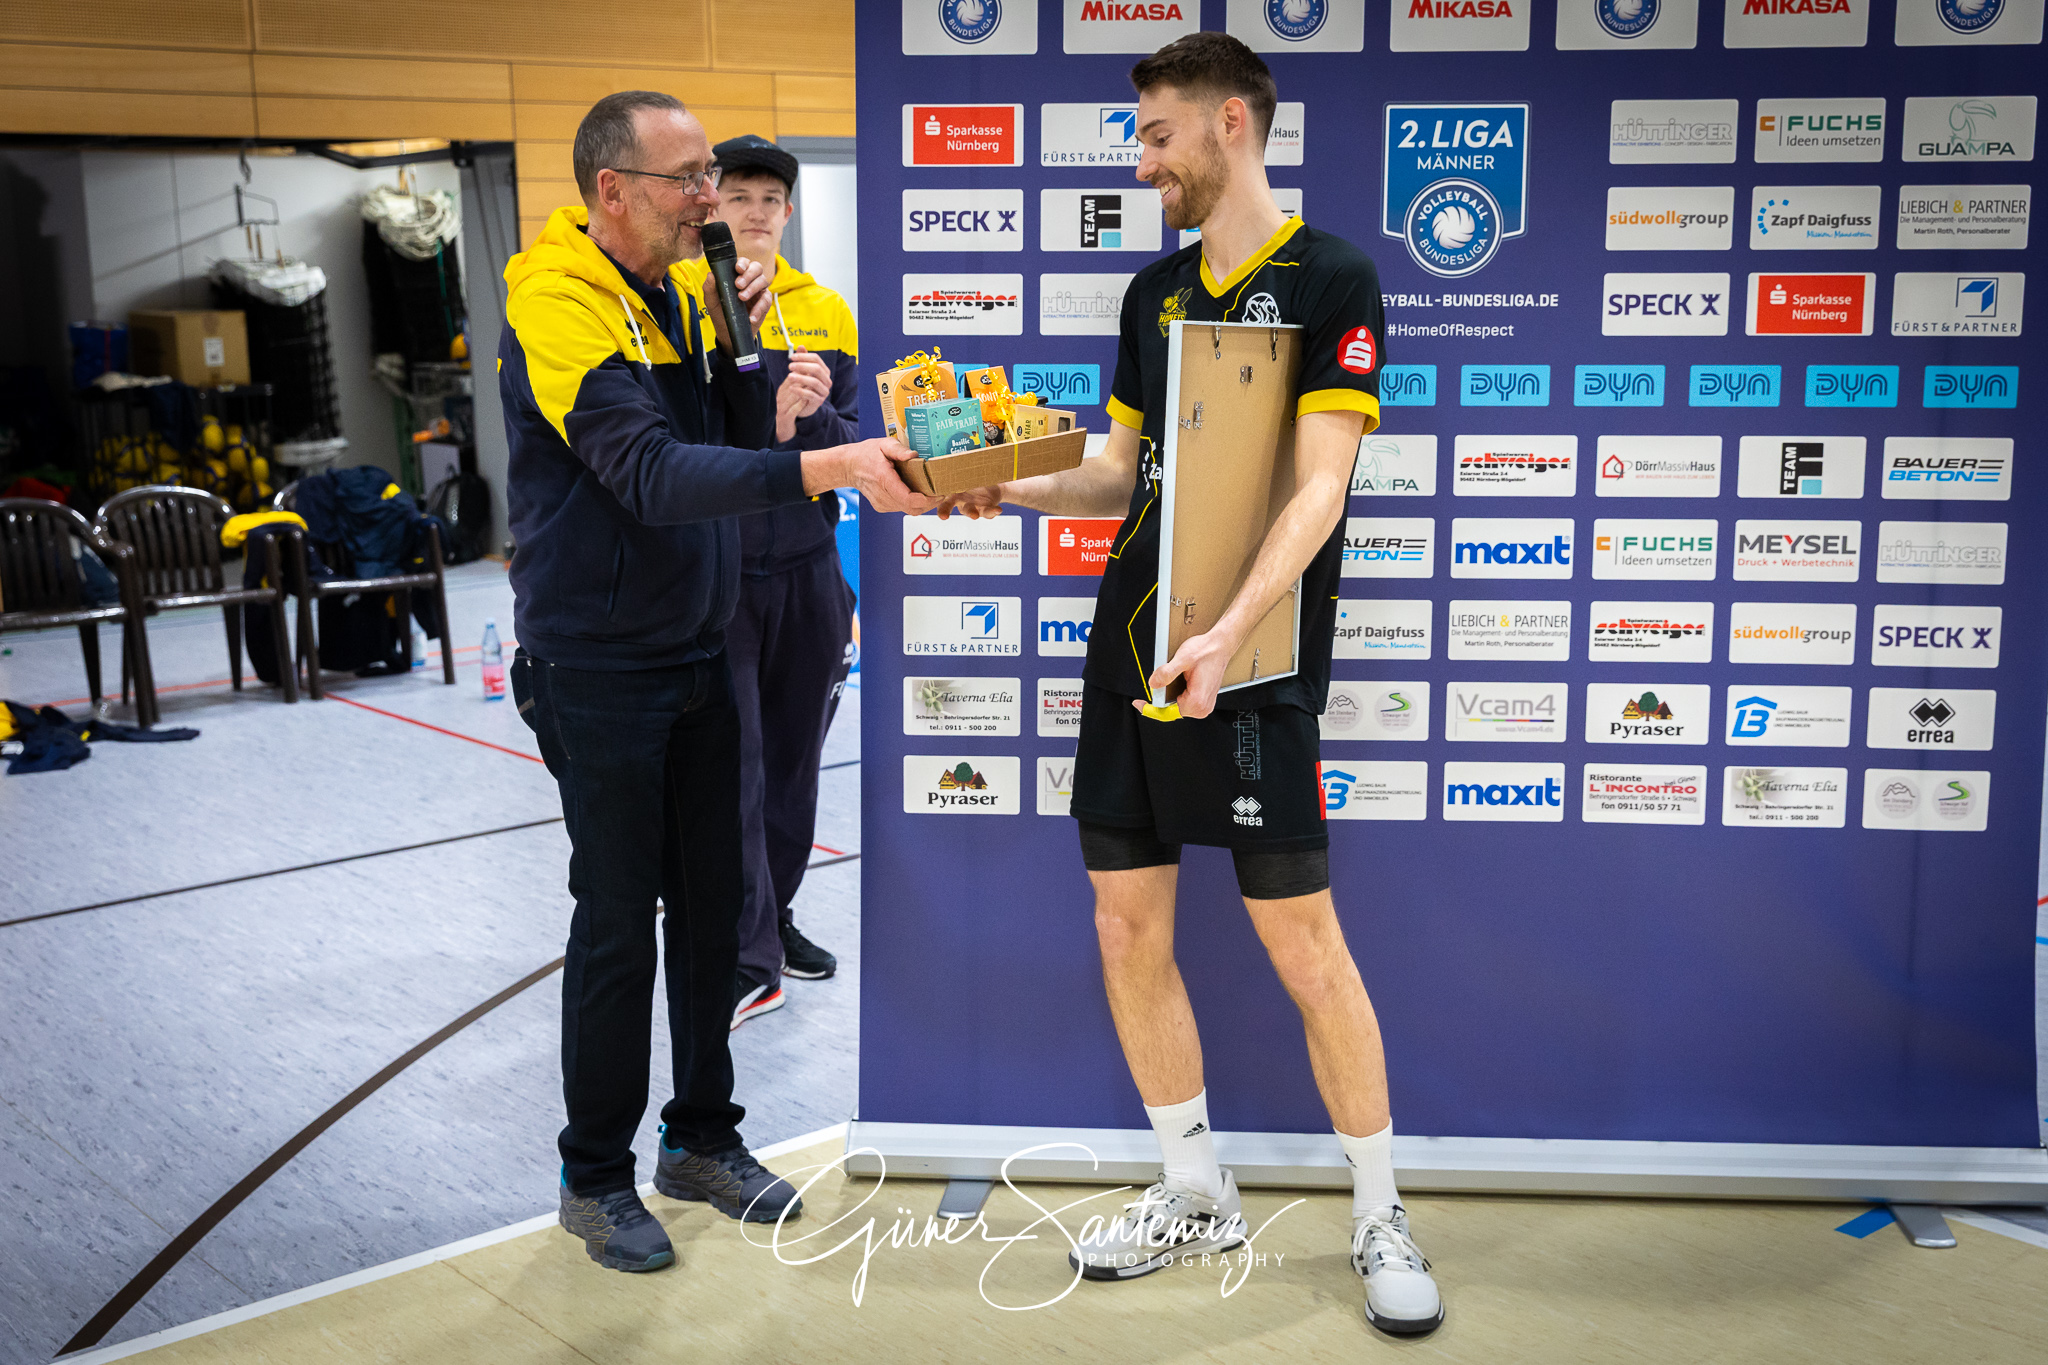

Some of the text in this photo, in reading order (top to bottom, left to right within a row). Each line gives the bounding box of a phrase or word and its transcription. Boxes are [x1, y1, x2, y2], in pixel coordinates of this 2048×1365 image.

[1742, 0, 1851, 15] MIKASA
[1604, 12, 1651, 31] BUNDESLIGA
[1946, 7, 1995, 27] BUNDESLIGA
[948, 18, 993, 37] BUNDESLIGA
[1274, 15, 1318, 34] BUNDESLIGA
[1613, 118, 1732, 141] HÜTTINGER
[1788, 115, 1882, 131] FUCHS
[947, 125, 1003, 137] Sparkasse
[1398, 120, 1513, 148] 2. LIGA
[947, 139, 999, 153] Nürnberg
[1786, 135, 1881, 147] Ideen umsetzen
[1919, 142, 2015, 156] GUAMPA
[1044, 151, 1141, 162] FÜRST & PARTN
[1417, 153, 1495, 169] MÄNNER
[1418, 191, 1489, 221] VOLLEYBALL
[1901, 200, 2027, 214] LIEBICH & PARTNER
[909, 210, 990, 232] SPECK
[1084, 199, 1095, 243] TEAM
[1771, 214, 1872, 229] Zapf Daigfuss
[1972, 217, 2026, 225] Personalberatung
[1419, 237, 1488, 265] BUNDESLIGA
[909, 291, 1017, 311] schweiger
[1043, 291, 1123, 313] HÜTTIN
[1382, 294, 1559, 307] EYBALL-BUNDESLIGA.DE
[1608, 294, 1693, 316] SPECK
[1792, 293, 1852, 306] Sparkasse
[1792, 309, 1848, 322] Nürnberg
[788, 327, 828, 337] Schwaig
[1387, 324, 1514, 339] #HomeOfRespect
[1894, 321, 2017, 332] FÜRST & PARTNER
[936, 417, 955, 432] FAIR
[954, 416, 978, 430] TRADE
[1460, 453, 1571, 473] schweiger
[1635, 460, 1715, 472] DörrMassivHaus
[1783, 446, 1797, 491] TEAM
[1893, 458, 1978, 469] BAUER
[1149, 464, 1163, 479] Za
[1888, 471, 1974, 482] BETON
[942, 540, 1019, 551] DörrMassivHaus
[1081, 537, 1111, 549] Spark
[1455, 535, 1570, 565] maxit
[1623, 537, 1713, 551] FUCHS
[1739, 535, 1856, 555] MEYSEL
[1081, 550, 1108, 562] Nürn
[1881, 540, 2001, 564] HÜTTINGER
[1622, 556, 1712, 566] Ideen umsetzen
[1738, 558, 1855, 568] Druck Werbetechnik
[1451, 615, 1568, 627] LIEBICH & PARTNER
[1333, 626, 1425, 639] Zapf Daigfuss
[1518, 630, 1568, 638] Personalberatung
[1594, 619, 1705, 639] schweiger
[1879, 626, 1964, 649] SPECK
[907, 642, 1018, 653] FÜRST & PARTNER
[942, 692, 1013, 703] Taverna Elia
[1458, 693, 1556, 716] Vcam4
[1055, 717, 1070, 725] fon
[1610, 722, 1684, 738] Pyraser
[1907, 729, 1954, 743] errea
[1590, 774, 1642, 782] Ristorante
[1447, 778, 1560, 806] maxit
[1762, 780, 1838, 792] Taverna Elia
[927, 792, 998, 808] Pyraser
[1617, 803, 1655, 811] 0911/50
[1233, 815, 1263, 826] errea
